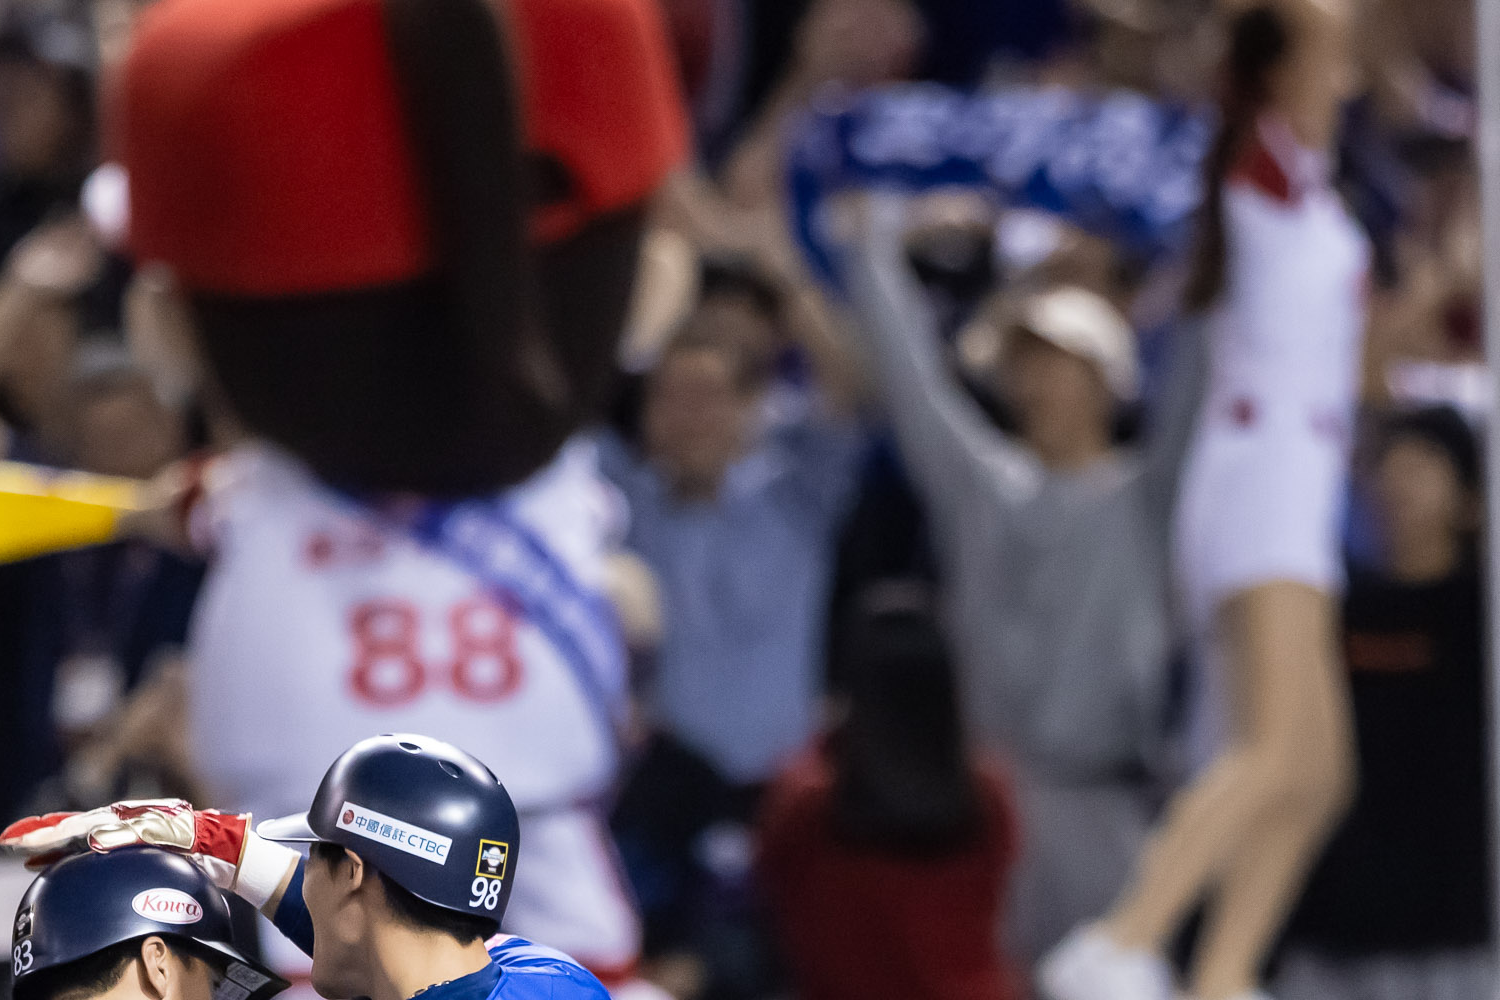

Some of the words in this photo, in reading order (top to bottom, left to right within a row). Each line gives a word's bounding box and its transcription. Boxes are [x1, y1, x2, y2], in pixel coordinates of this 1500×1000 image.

[348, 598, 524, 706] 88
[355, 816, 407, 844] 中國信託
[407, 834, 447, 857] CTBC
[141, 894, 201, 916] Kowa
[469, 876, 502, 911] 98
[13, 939, 35, 976] 83
